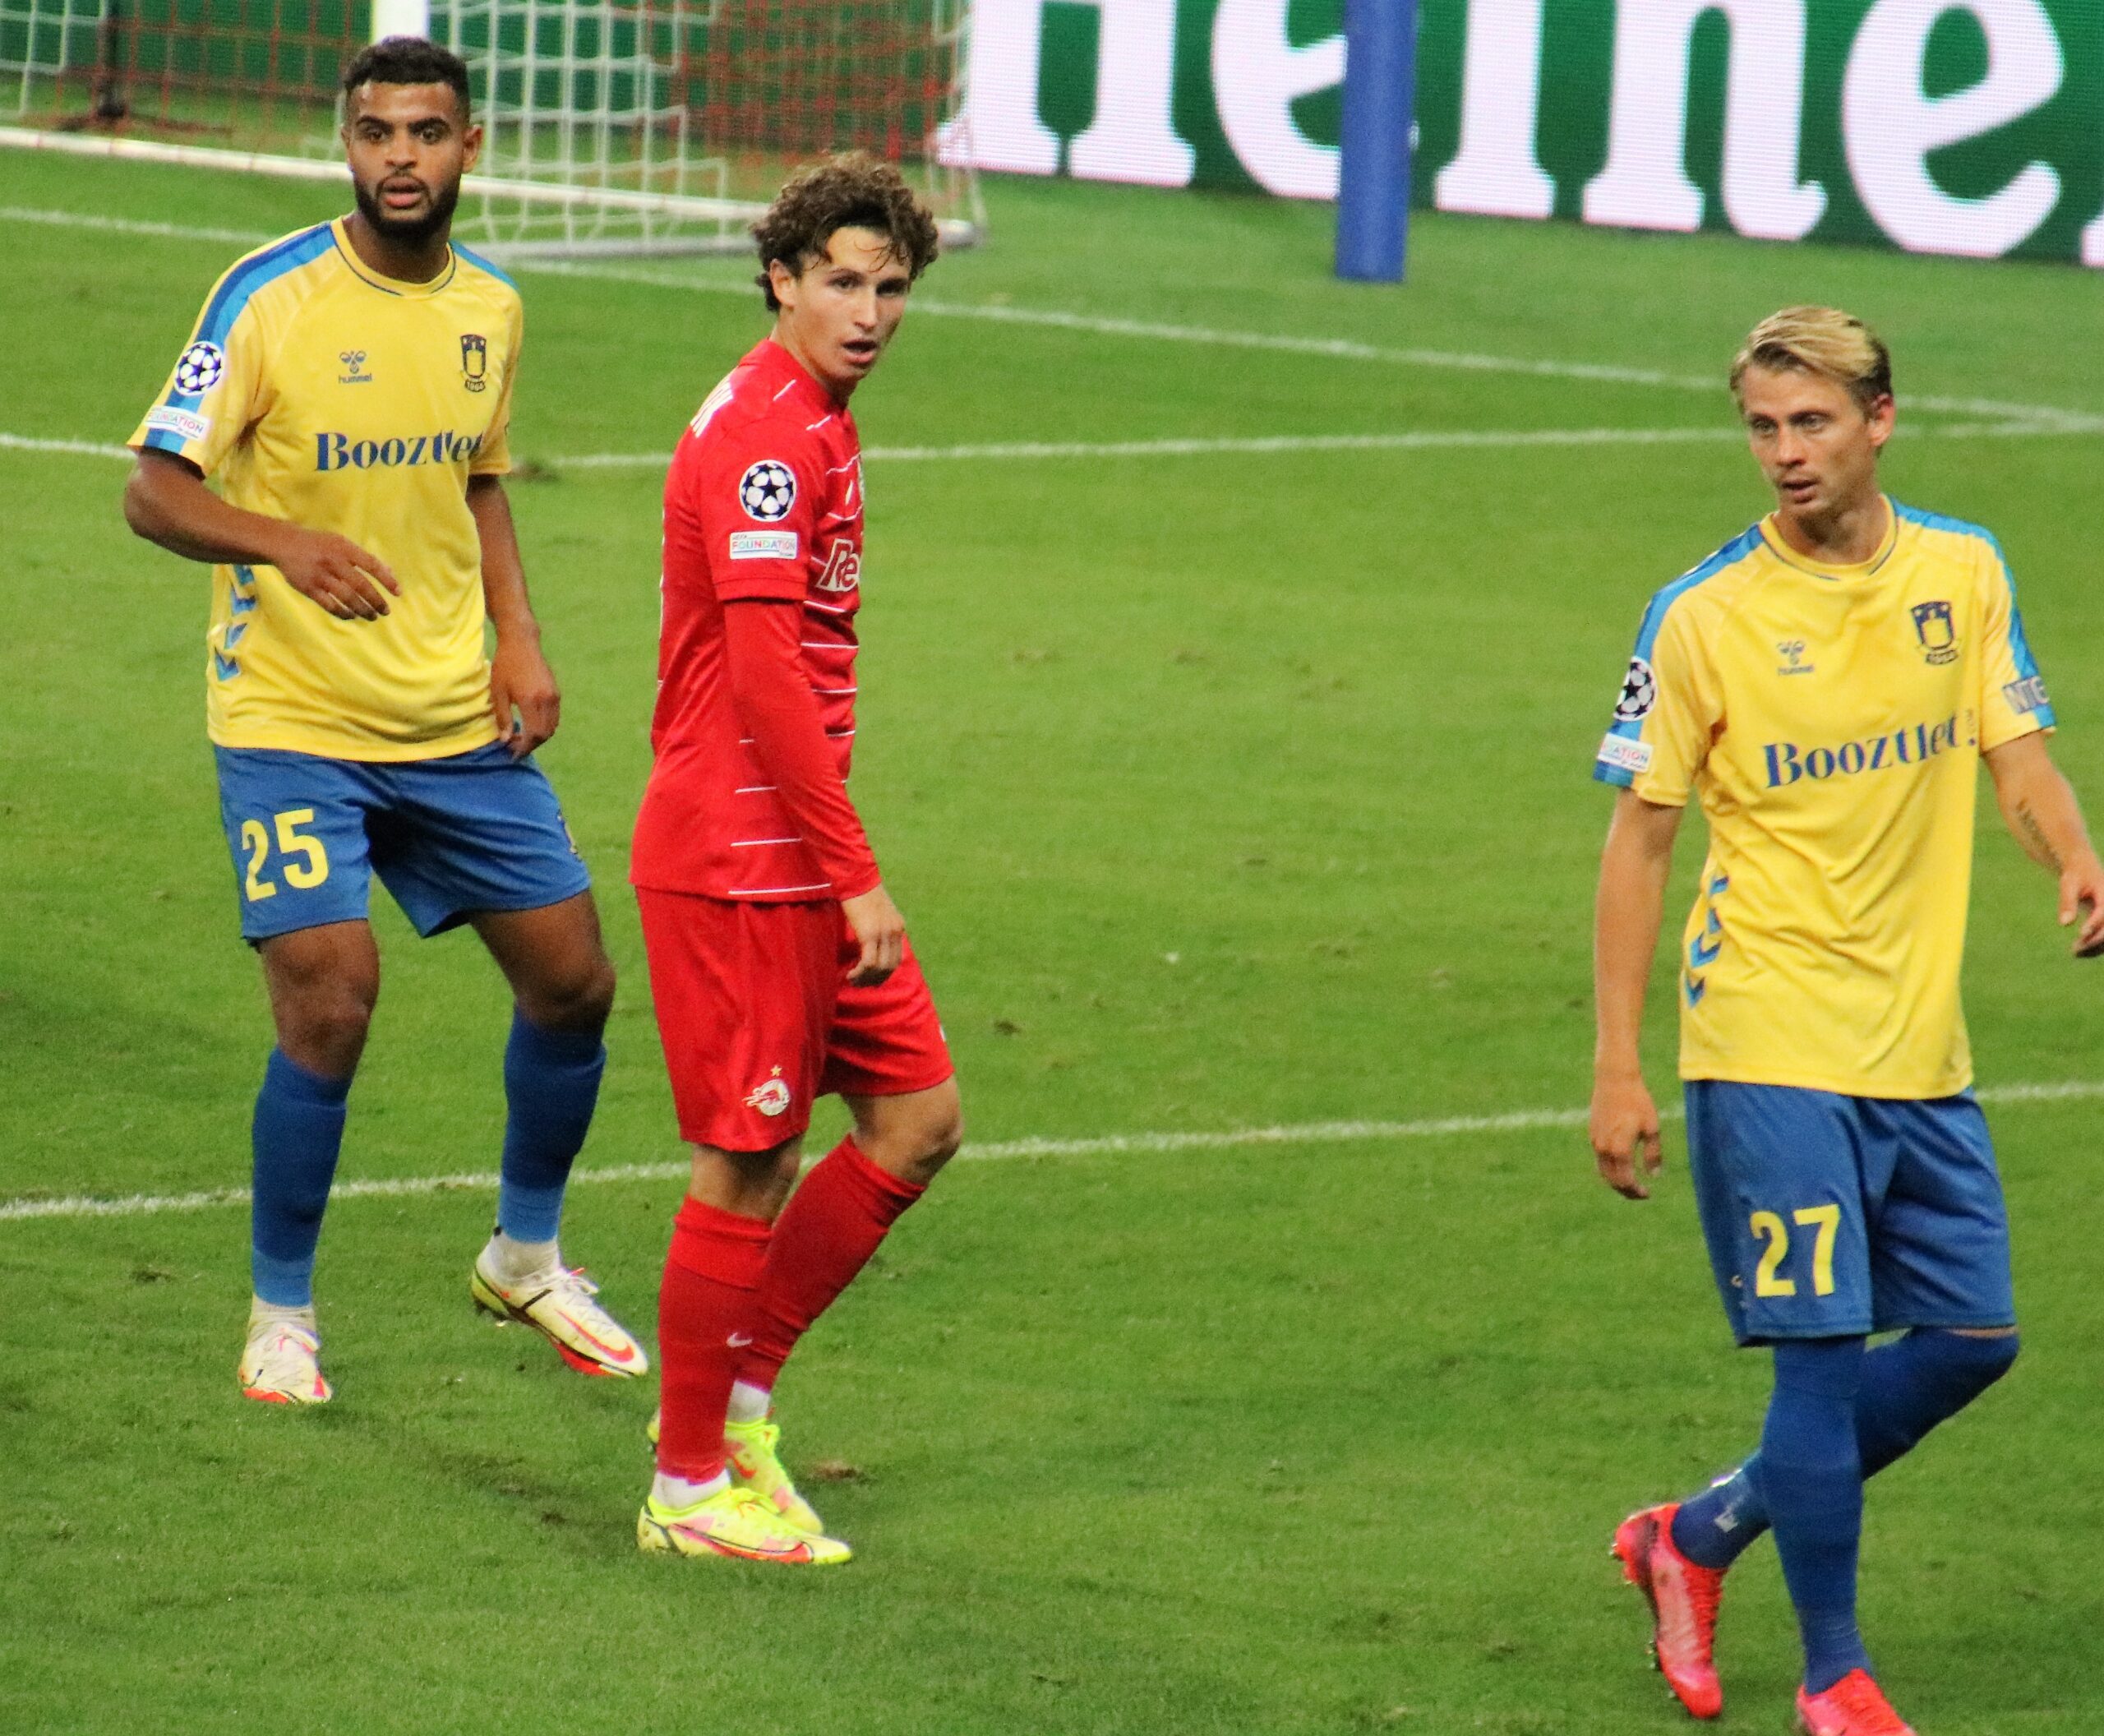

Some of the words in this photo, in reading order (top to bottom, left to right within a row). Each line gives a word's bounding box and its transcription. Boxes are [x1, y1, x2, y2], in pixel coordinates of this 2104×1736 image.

[935, 0, 2104, 267] Heine
[815, 538, 861, 592] Re
[241, 808, 329, 902] 25
[1749, 1203, 1842, 1297] 27
